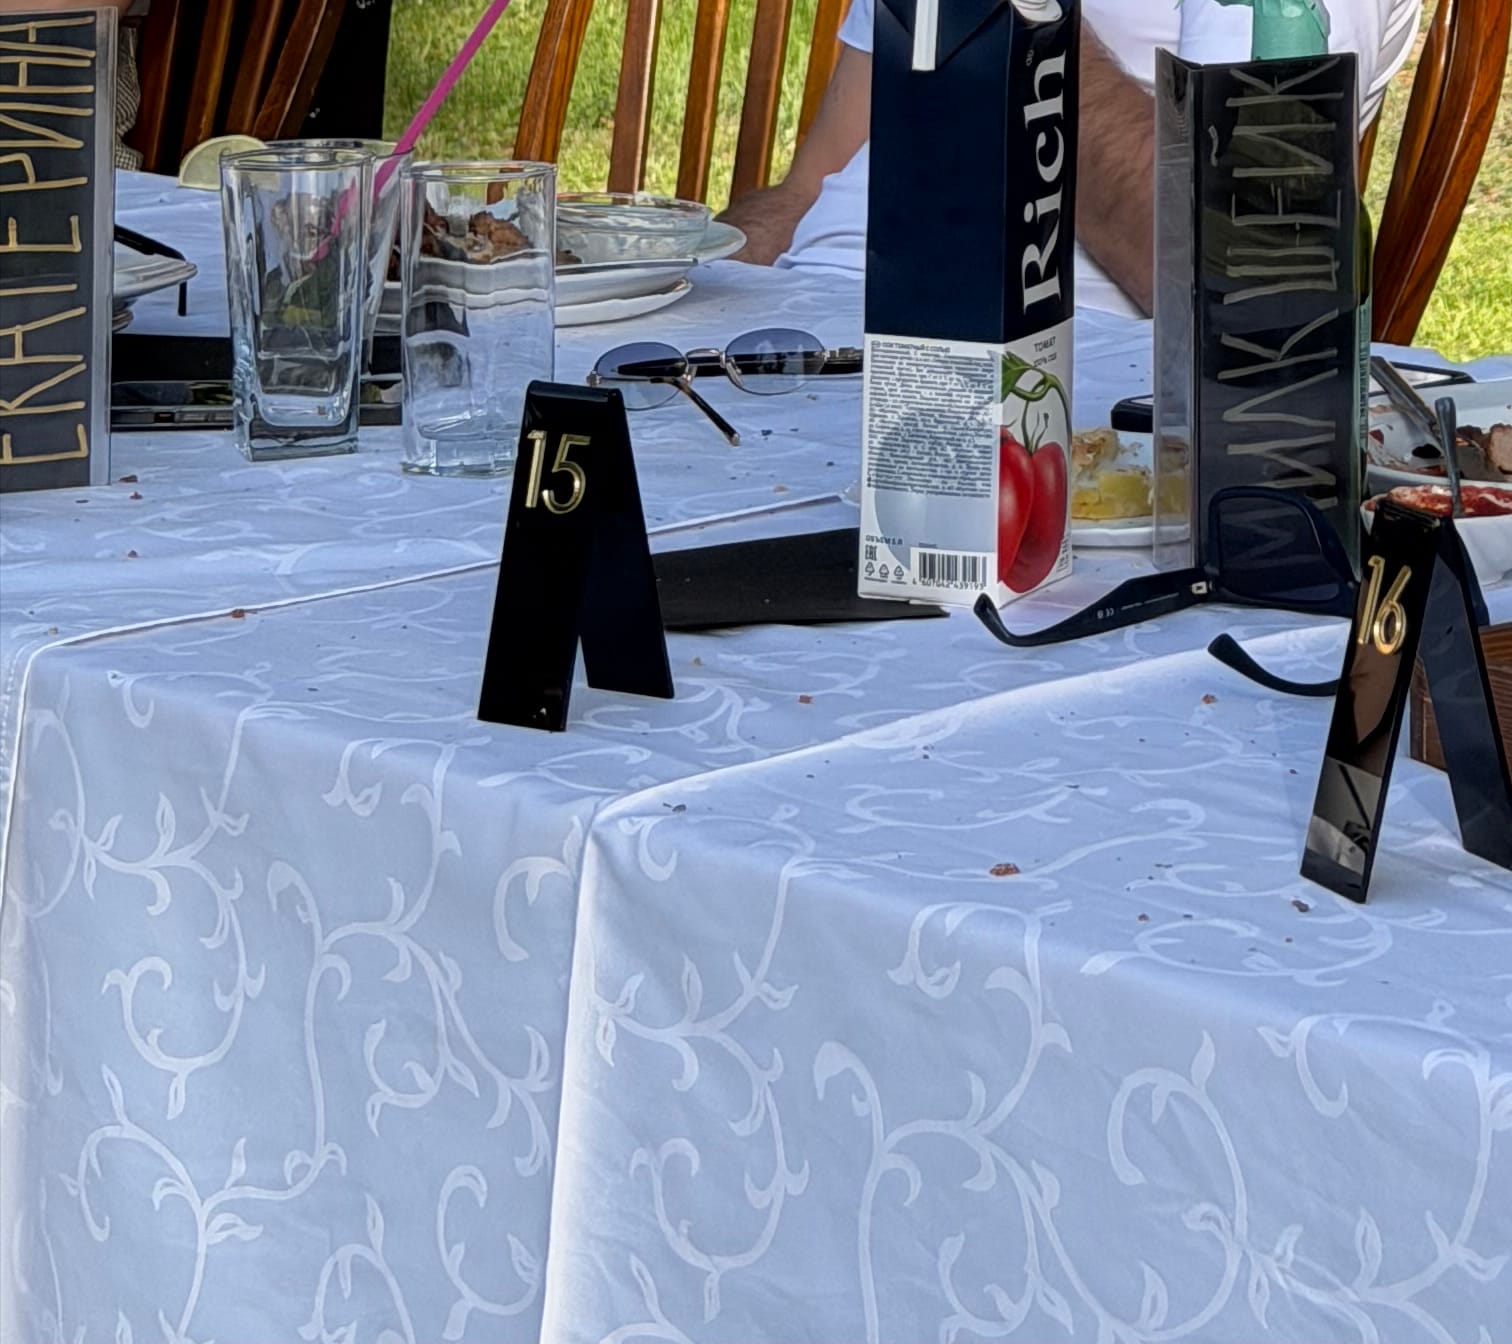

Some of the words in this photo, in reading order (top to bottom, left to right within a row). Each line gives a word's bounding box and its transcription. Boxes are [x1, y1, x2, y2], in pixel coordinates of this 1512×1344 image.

[1021, 49, 1067, 315] Rich
[525, 429, 592, 516] 15
[1358, 555, 1412, 655] 16
